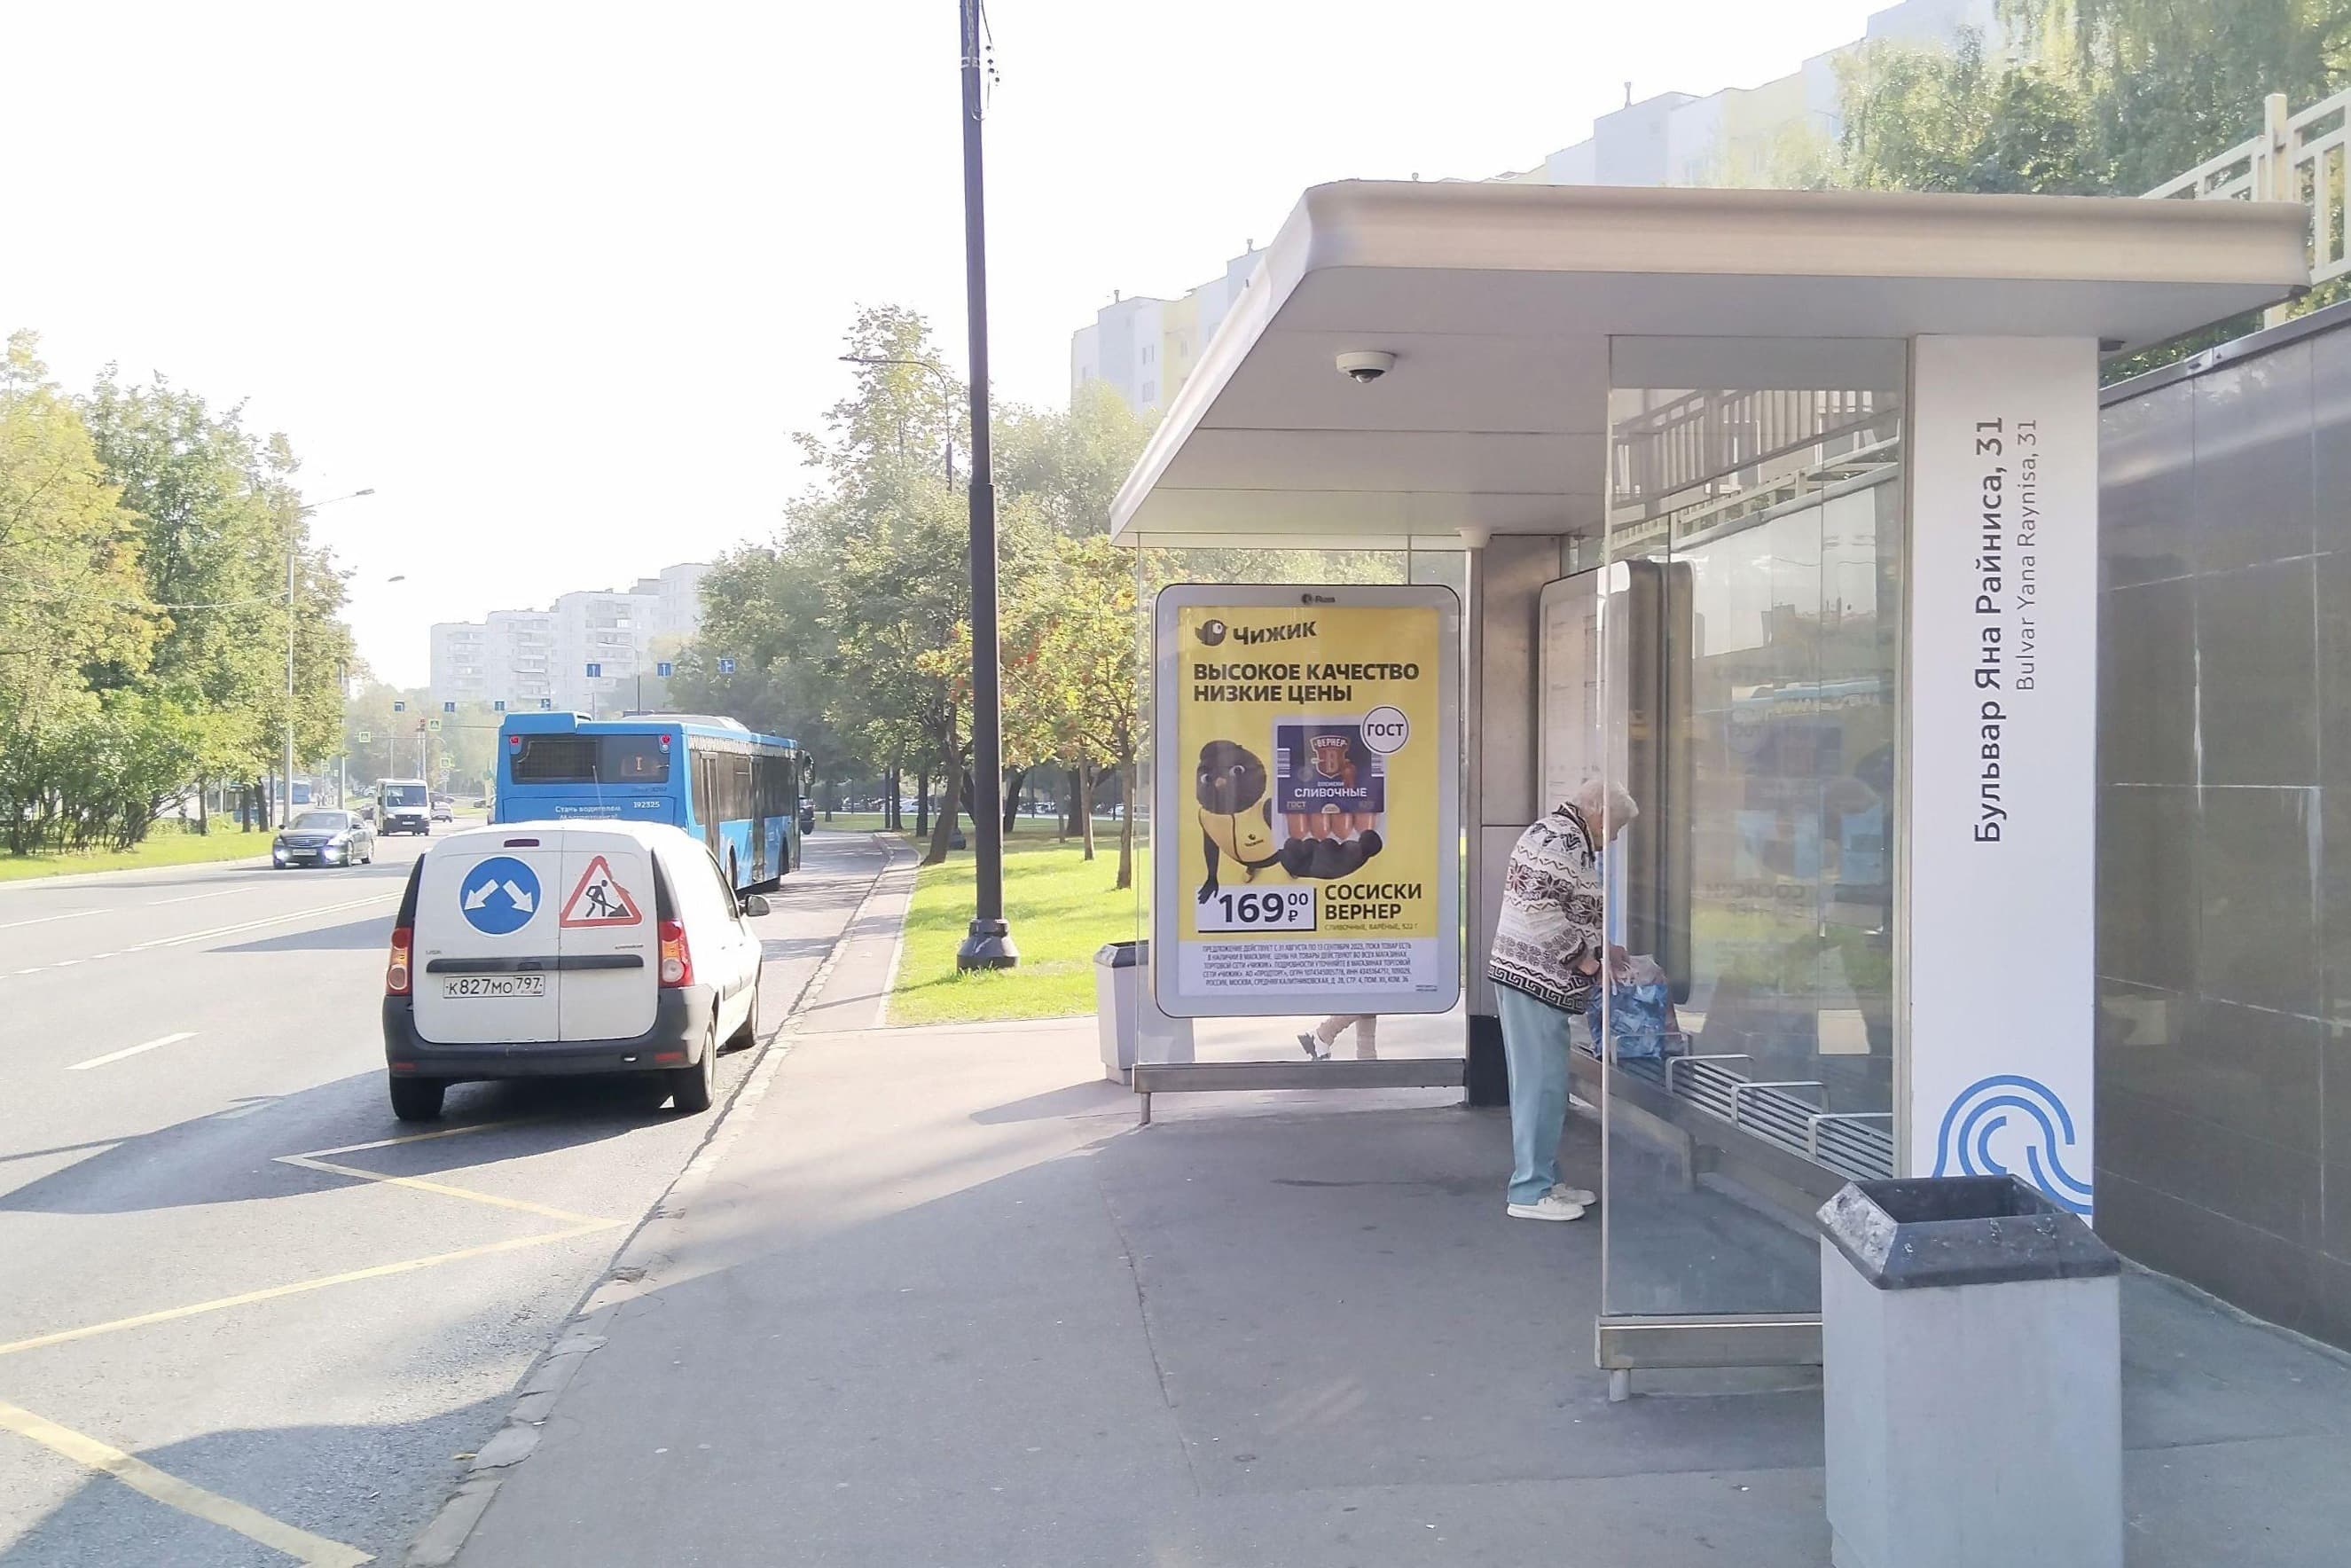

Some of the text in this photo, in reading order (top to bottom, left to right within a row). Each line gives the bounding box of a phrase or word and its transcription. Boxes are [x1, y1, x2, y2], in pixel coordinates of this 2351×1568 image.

[2017, 419, 2041, 691] Bulvar Yana Raynisa, 31
[1975, 417, 2008, 843] Бульвар Яна Райниса, 31
[1194, 662, 1420, 681] ВЫСОКОЕ КАЧЕСТВО
[1194, 685, 1352, 704] НИЗКИЕ ЦЕНЫ
[1367, 724, 1405, 737] ГОСТ
[1294, 788, 1367, 798] СЛИВОЧНЫЕ
[1324, 883, 1422, 900] СОСИСКИ
[1219, 892, 1309, 922] 169 00
[1324, 903, 1402, 921] ВЕРНЕР
[449, 977, 540, 995] К827МО 797
